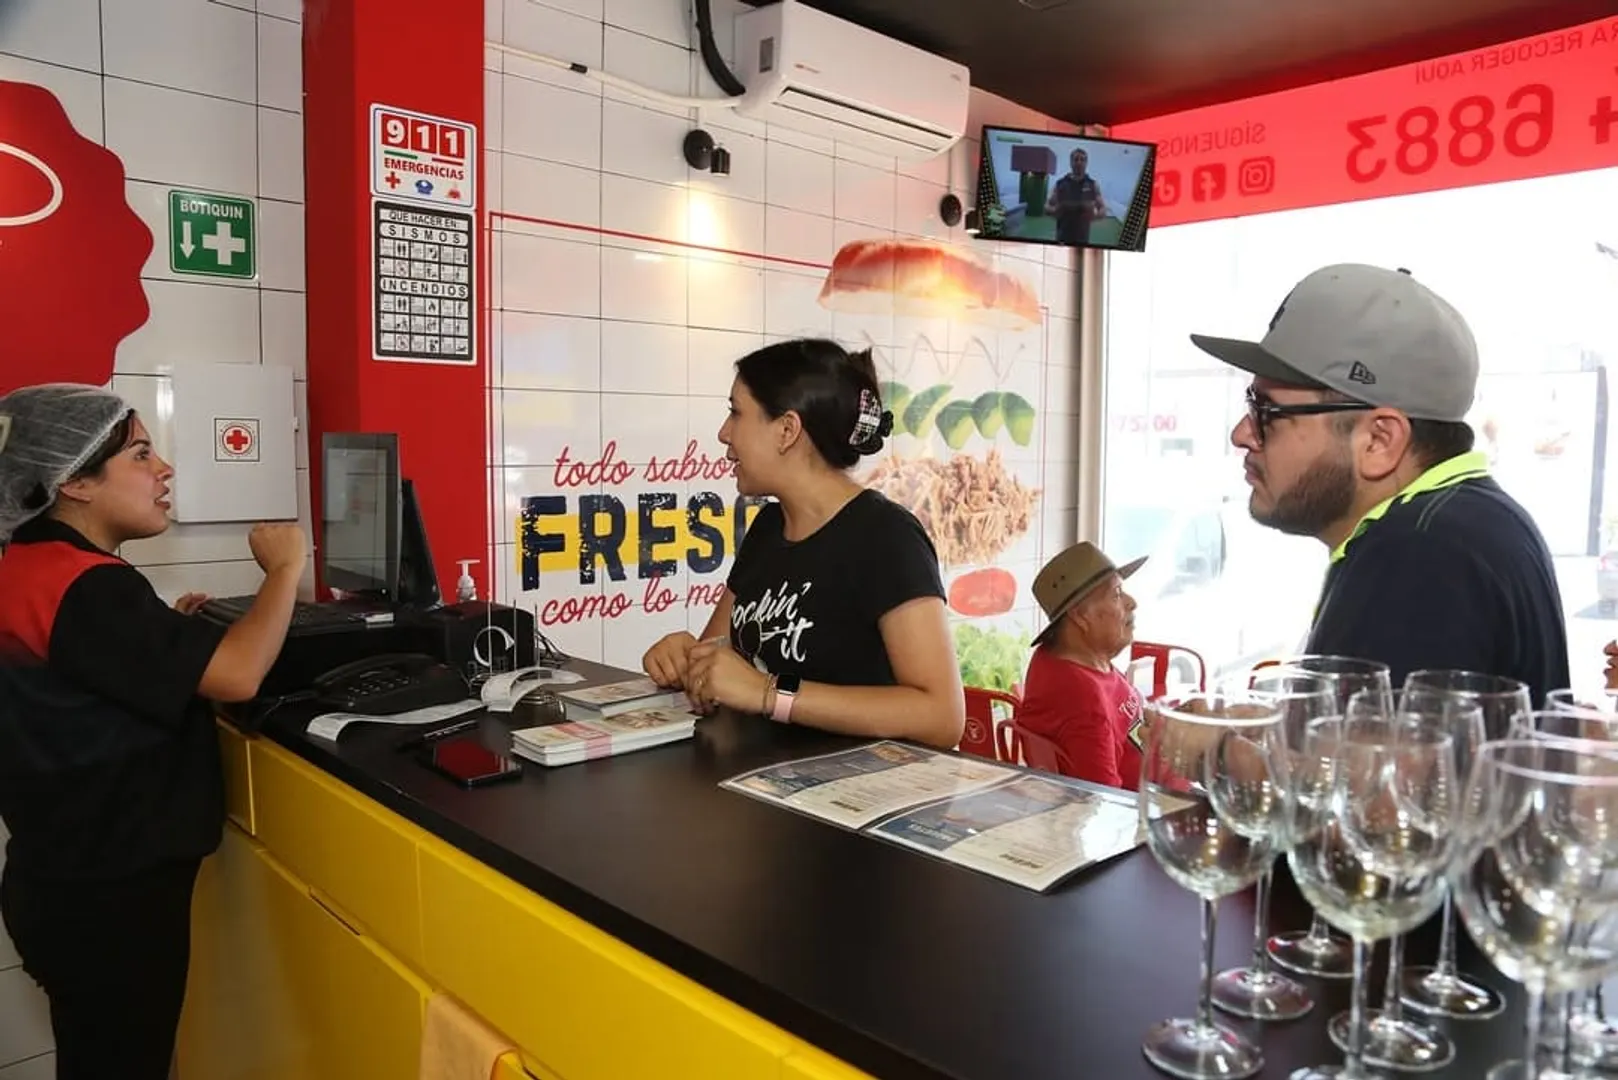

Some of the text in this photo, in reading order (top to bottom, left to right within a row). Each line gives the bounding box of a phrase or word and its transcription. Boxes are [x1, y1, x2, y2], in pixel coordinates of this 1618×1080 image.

[386, 119, 458, 155] 911
[384, 158, 464, 180] EMERGENCIAS
[180, 199, 243, 219] BOTIQUIN
[389, 211, 457, 228] QUE HACER EN
[388, 225, 461, 244] SISMOS
[382, 279, 466, 297] INCENDIOS
[554, 440, 635, 487] todo
[541, 592, 632, 626] como
[643, 572, 679, 614] lo
[732, 581, 812, 629] ockin'
[780, 617, 814, 662] it
